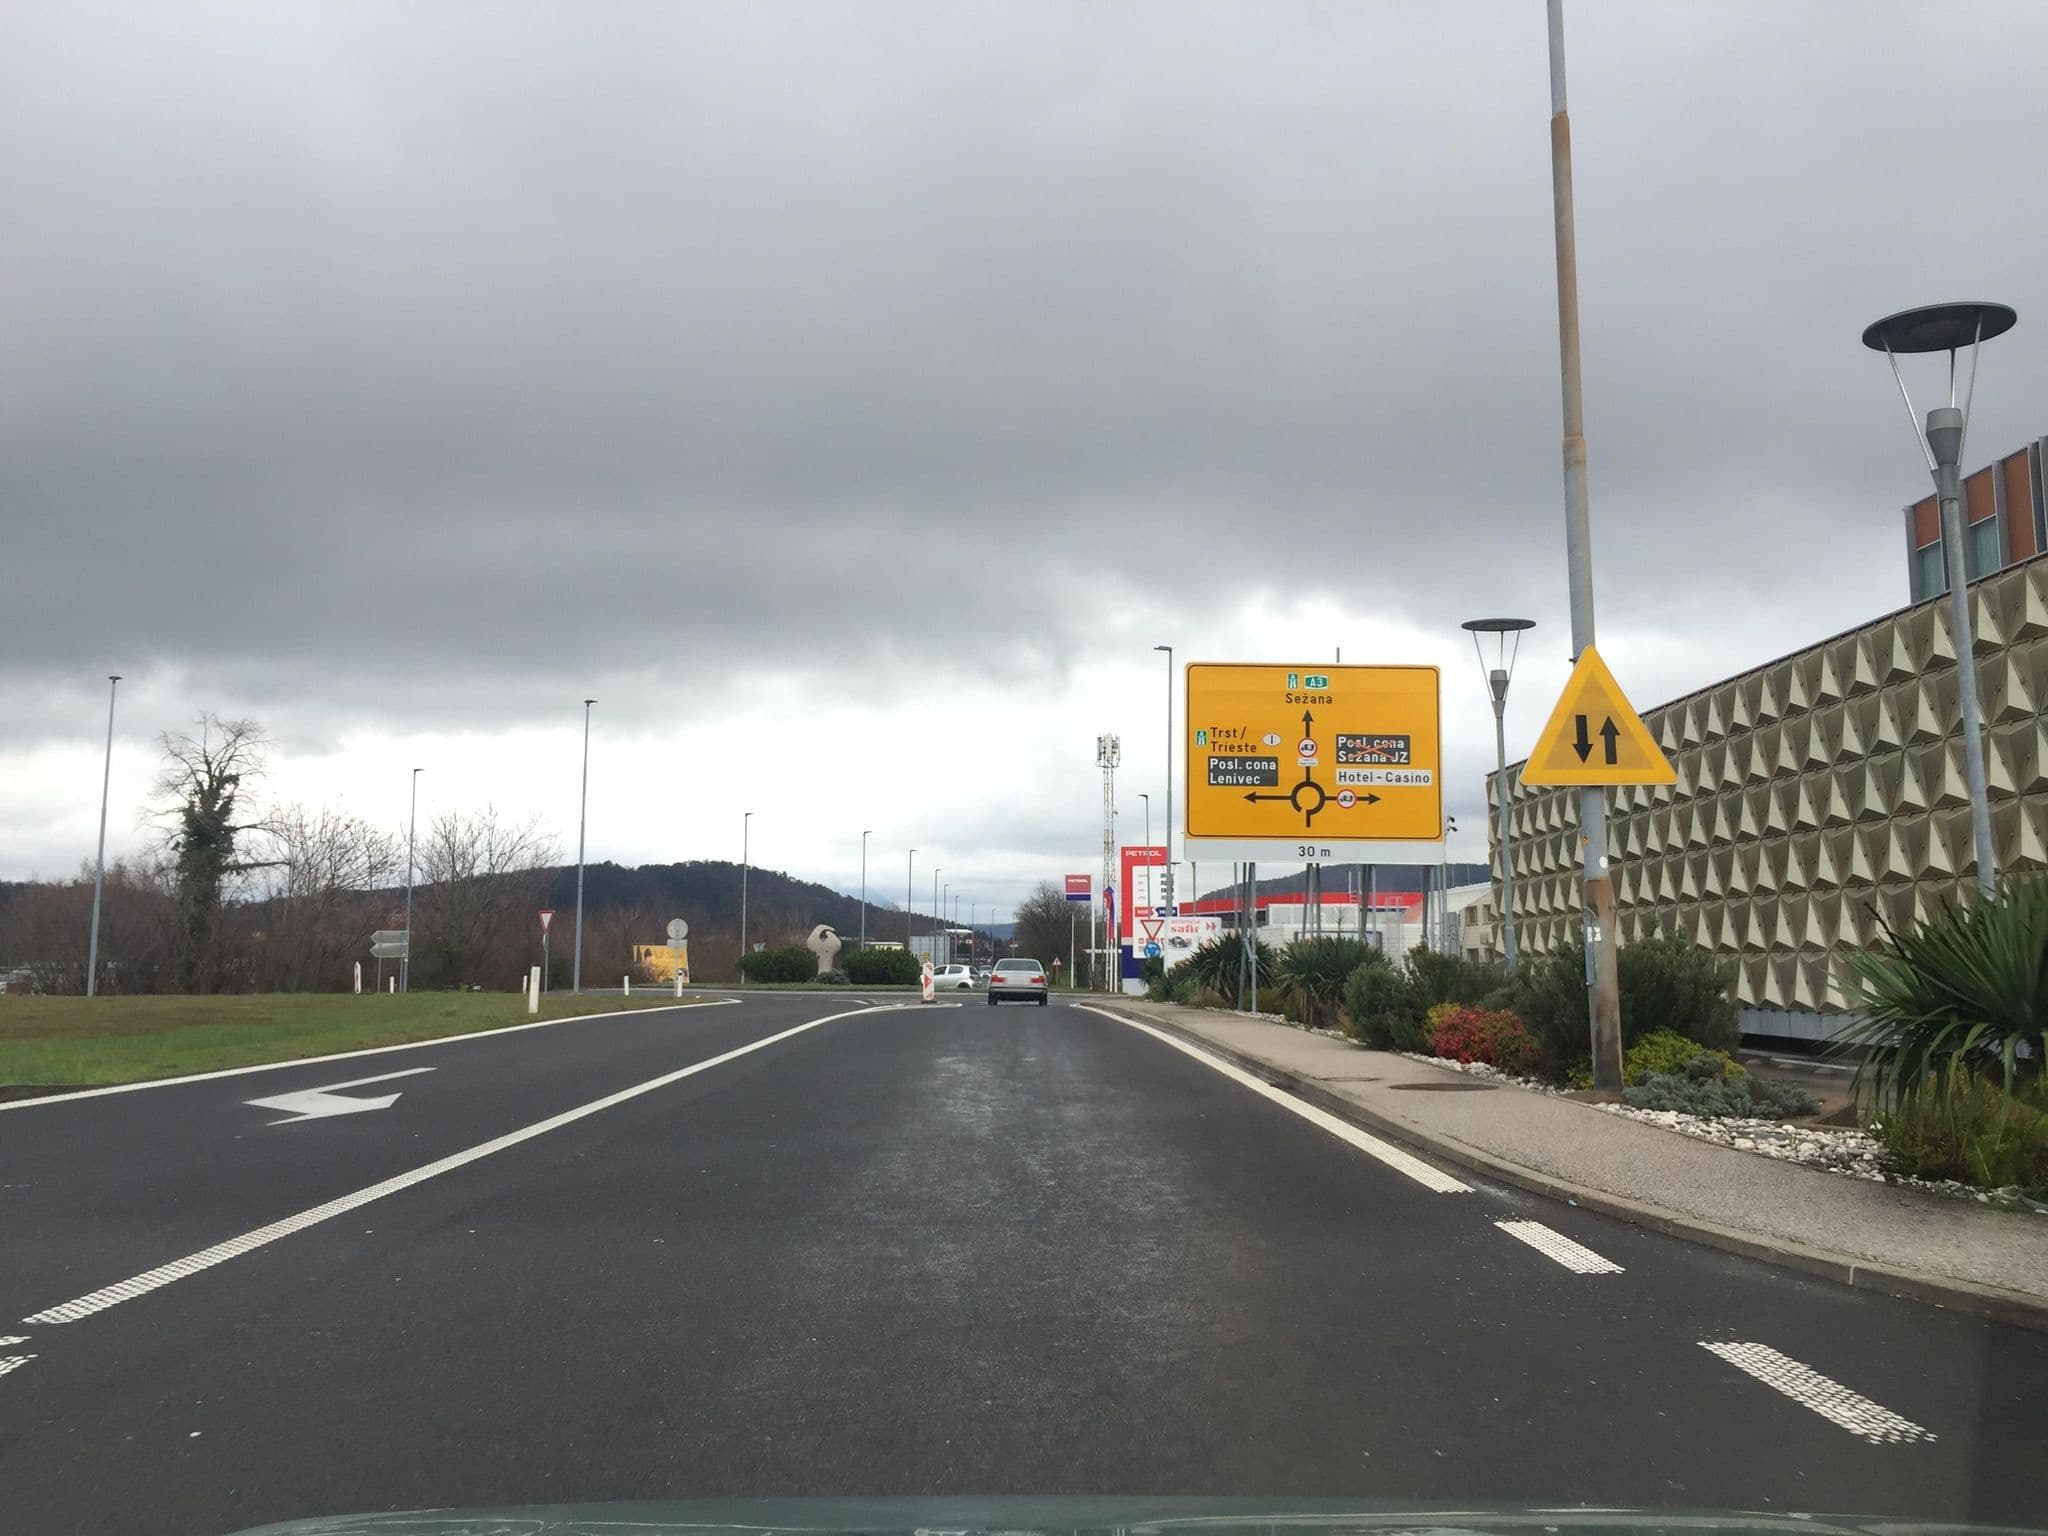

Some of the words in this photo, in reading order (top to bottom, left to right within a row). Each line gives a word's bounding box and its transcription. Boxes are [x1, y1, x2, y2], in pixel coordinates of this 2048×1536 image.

[1310, 677, 1324, 688] A3
[1285, 693, 1333, 705] Sežana
[1210, 741, 1257, 753] Trieste
[1338, 737, 1367, 749] Posl.
[1373, 739, 1405, 749] cona
[1391, 751, 1409, 763] JZ
[1209, 758, 1243, 771] Posl.
[1245, 760, 1277, 771] cona
[1209, 772, 1261, 785] Lenivec
[1298, 846, 1314, 857] 30
[1320, 848, 1331, 857] m
